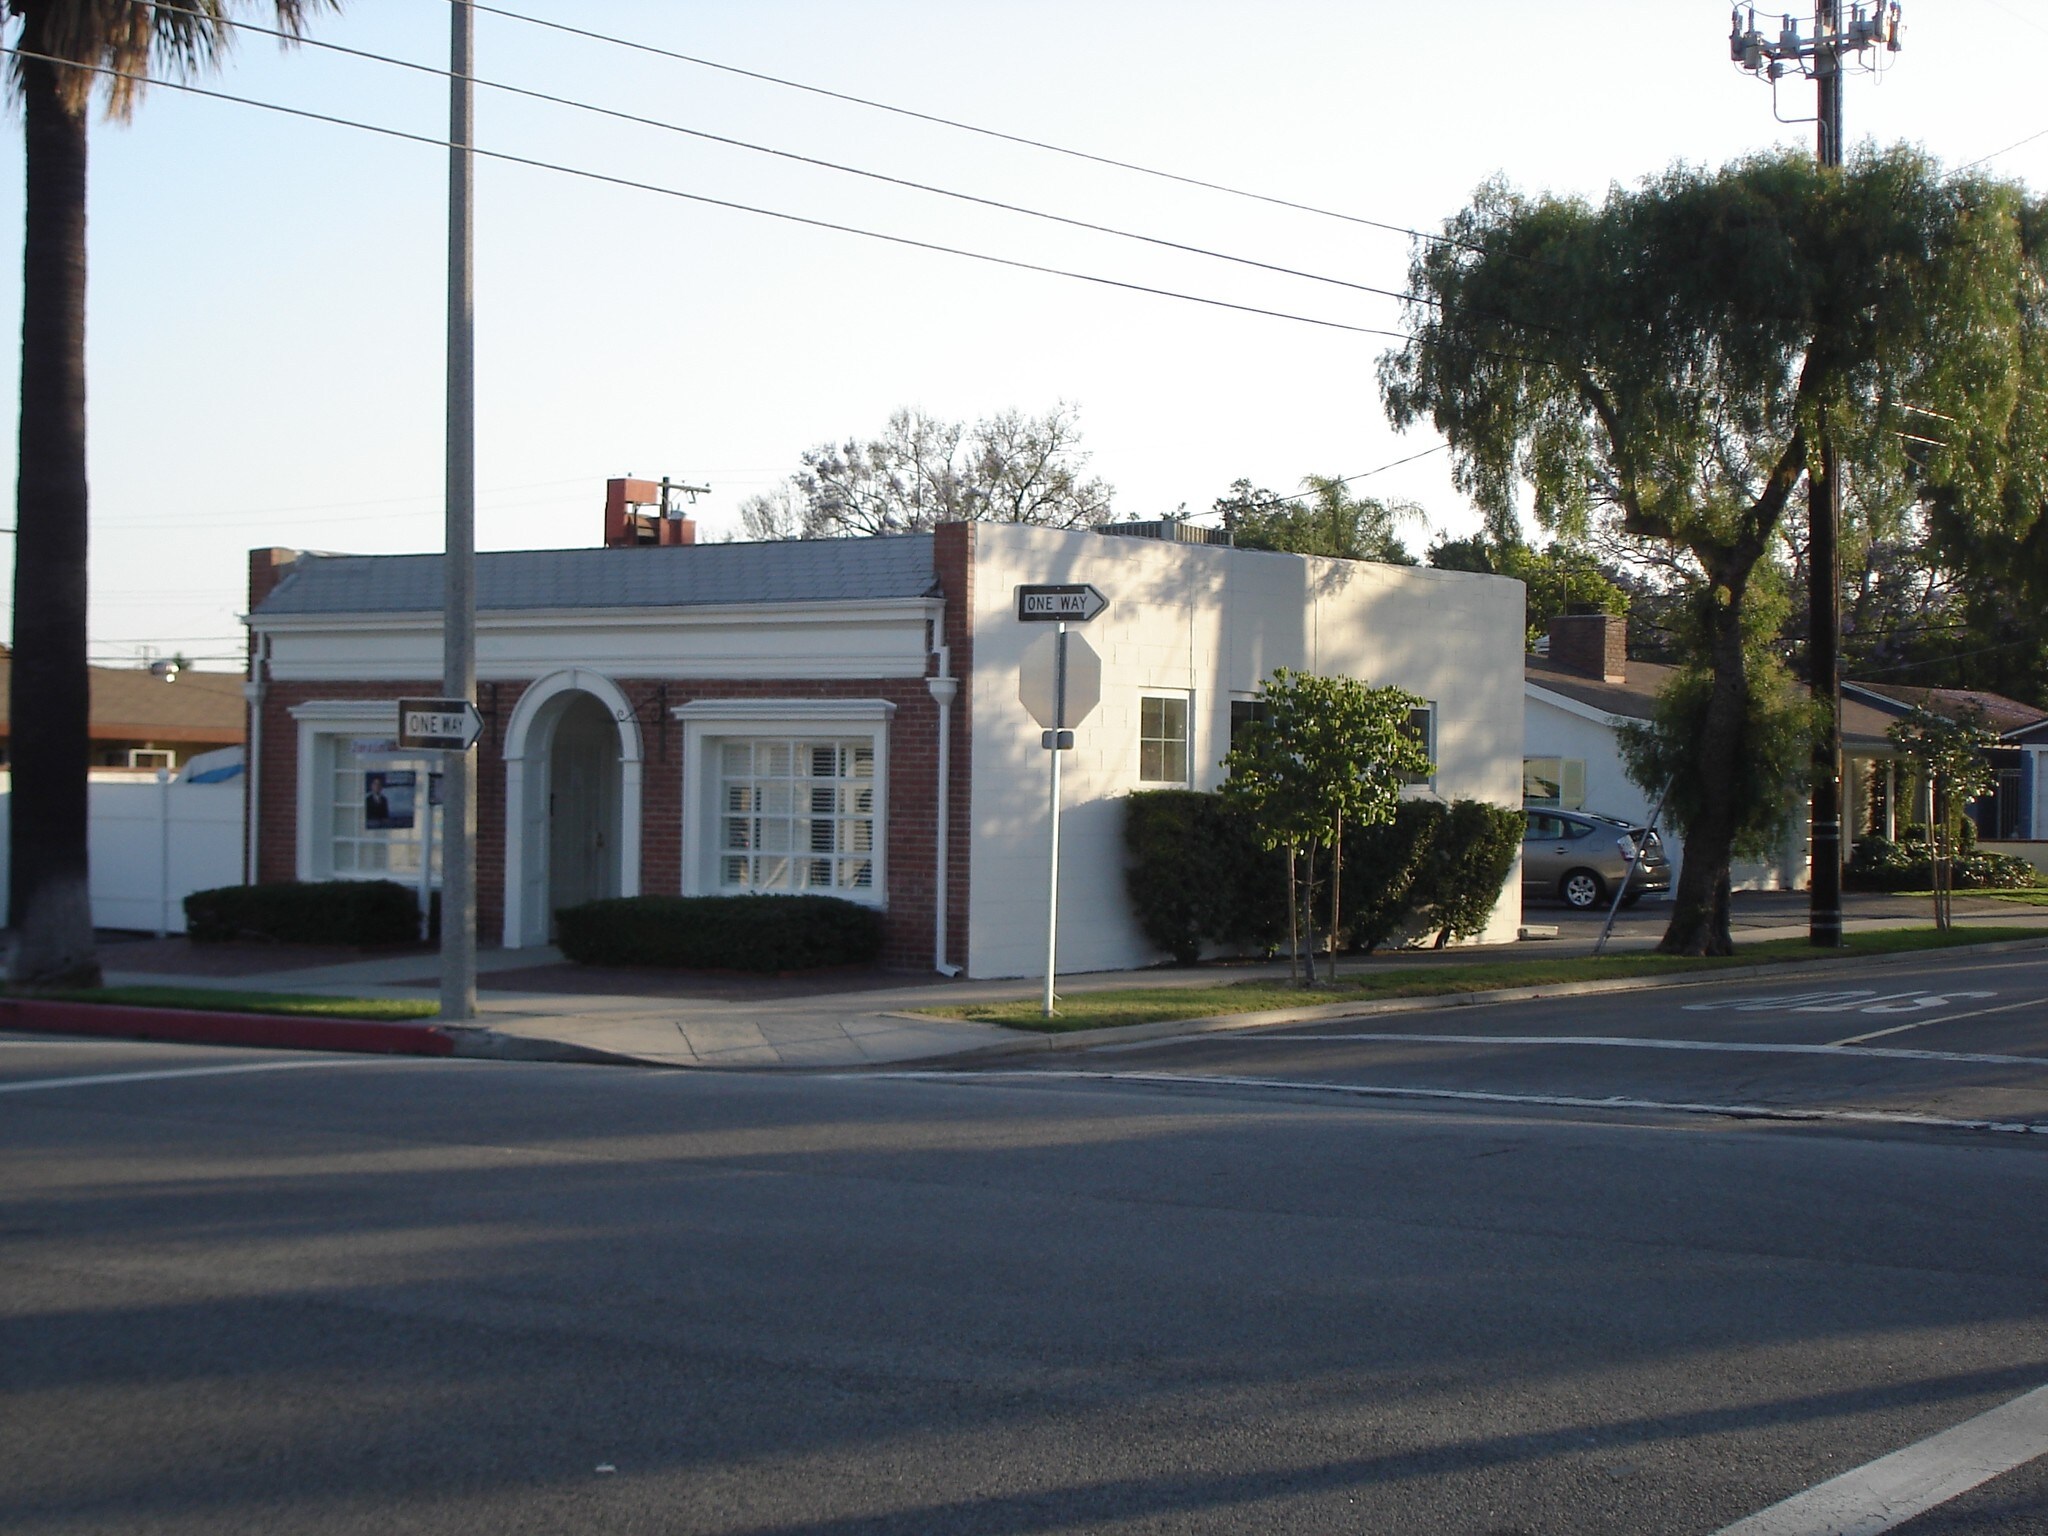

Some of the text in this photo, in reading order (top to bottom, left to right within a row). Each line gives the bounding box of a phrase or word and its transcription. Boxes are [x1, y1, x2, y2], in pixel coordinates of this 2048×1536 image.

[1027, 596, 1088, 611] ONE WAY
[410, 714, 464, 734] ONE WAY
[1681, 990, 1999, 1014] STOP
